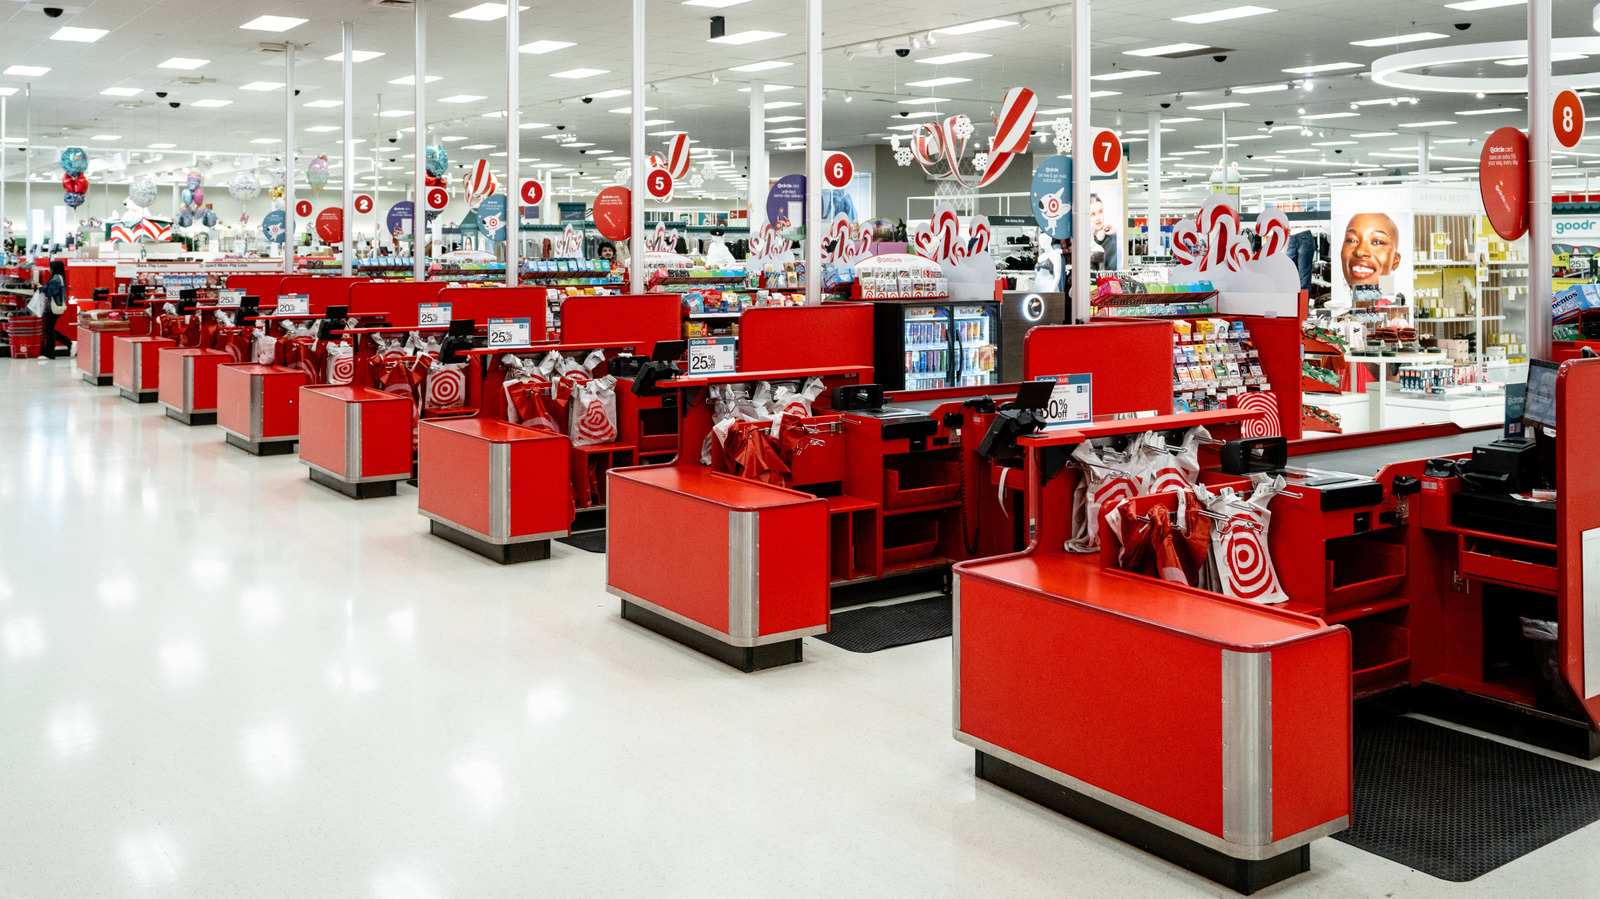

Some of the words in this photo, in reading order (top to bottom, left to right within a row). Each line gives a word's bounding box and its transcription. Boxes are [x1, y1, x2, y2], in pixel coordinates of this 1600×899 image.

[1562, 105, 1573, 133] 8
[1101, 141, 1112, 162] 7
[833, 162, 843, 178] 6
[654, 176, 664, 190] 5
[434, 193, 441, 204] 3
[528, 186, 536, 199] 4
[1420, 193, 1447, 202] KENDRA
[1449, 195, 1470, 203] SCOTT
[301, 204, 307, 214] 1
[359, 199, 368, 209] 2
[1555, 219, 1597, 235] goodr
[1057, 410, 1068, 418] off
